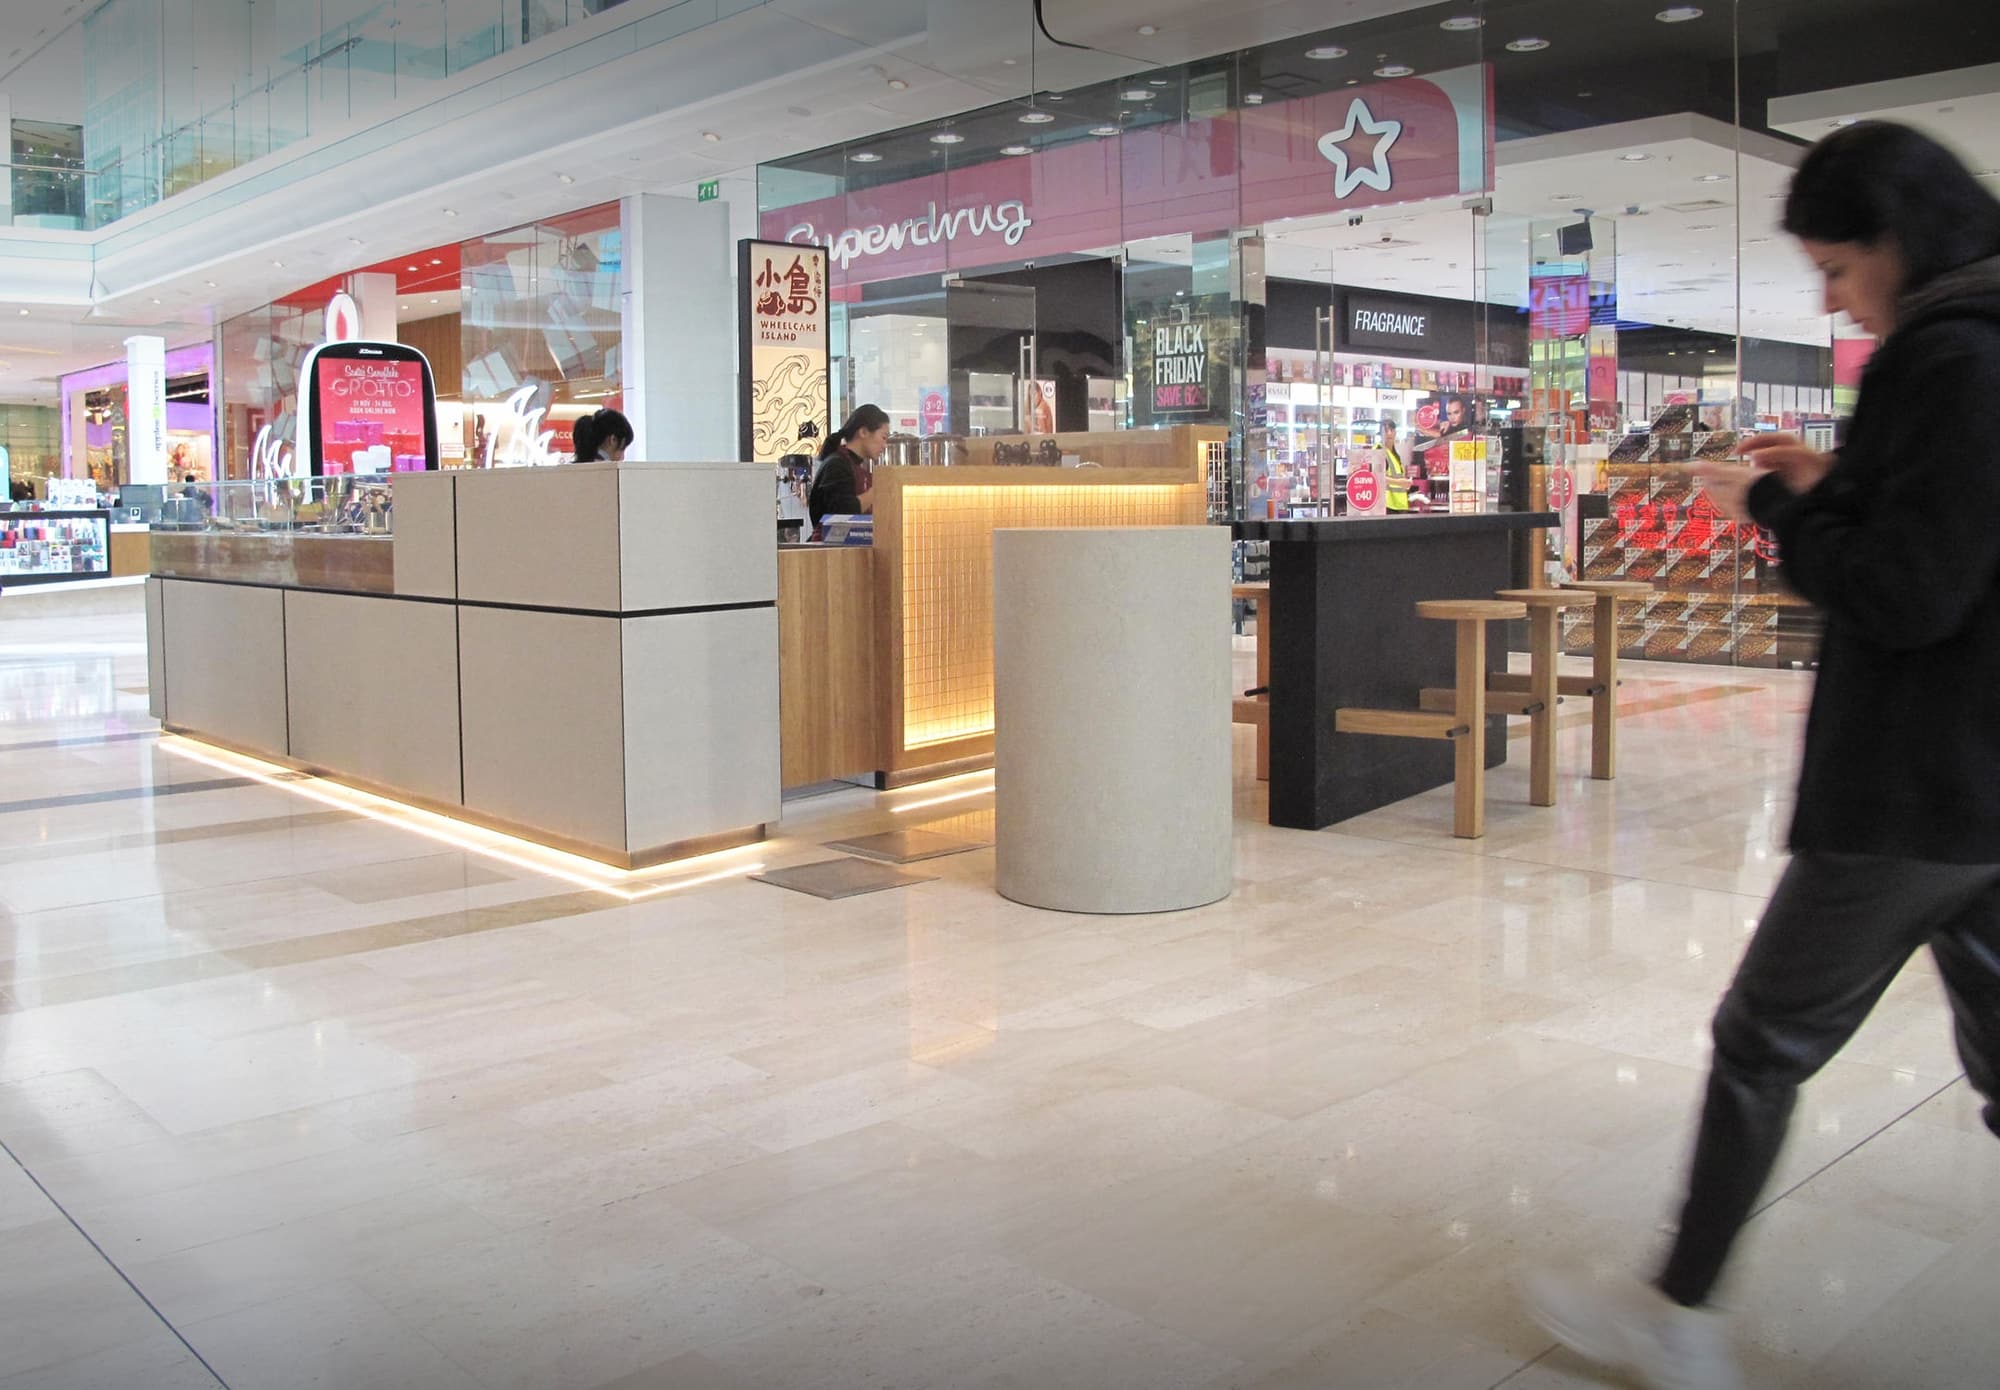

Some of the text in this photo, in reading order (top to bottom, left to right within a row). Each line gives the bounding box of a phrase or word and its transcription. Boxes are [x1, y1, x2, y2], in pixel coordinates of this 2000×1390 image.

[760, 320, 817, 332] WHEELCAKE
[1354, 309, 1425, 336] FRAGRANCE
[761, 331, 797, 341] ISLAND
[1156, 325, 1204, 356] BLACK
[1155, 355, 1206, 385] FRIDAY
[1156, 385, 1182, 407] SAVE
[1353, 477, 1373, 485] save
[1356, 490, 1372, 501] £40
